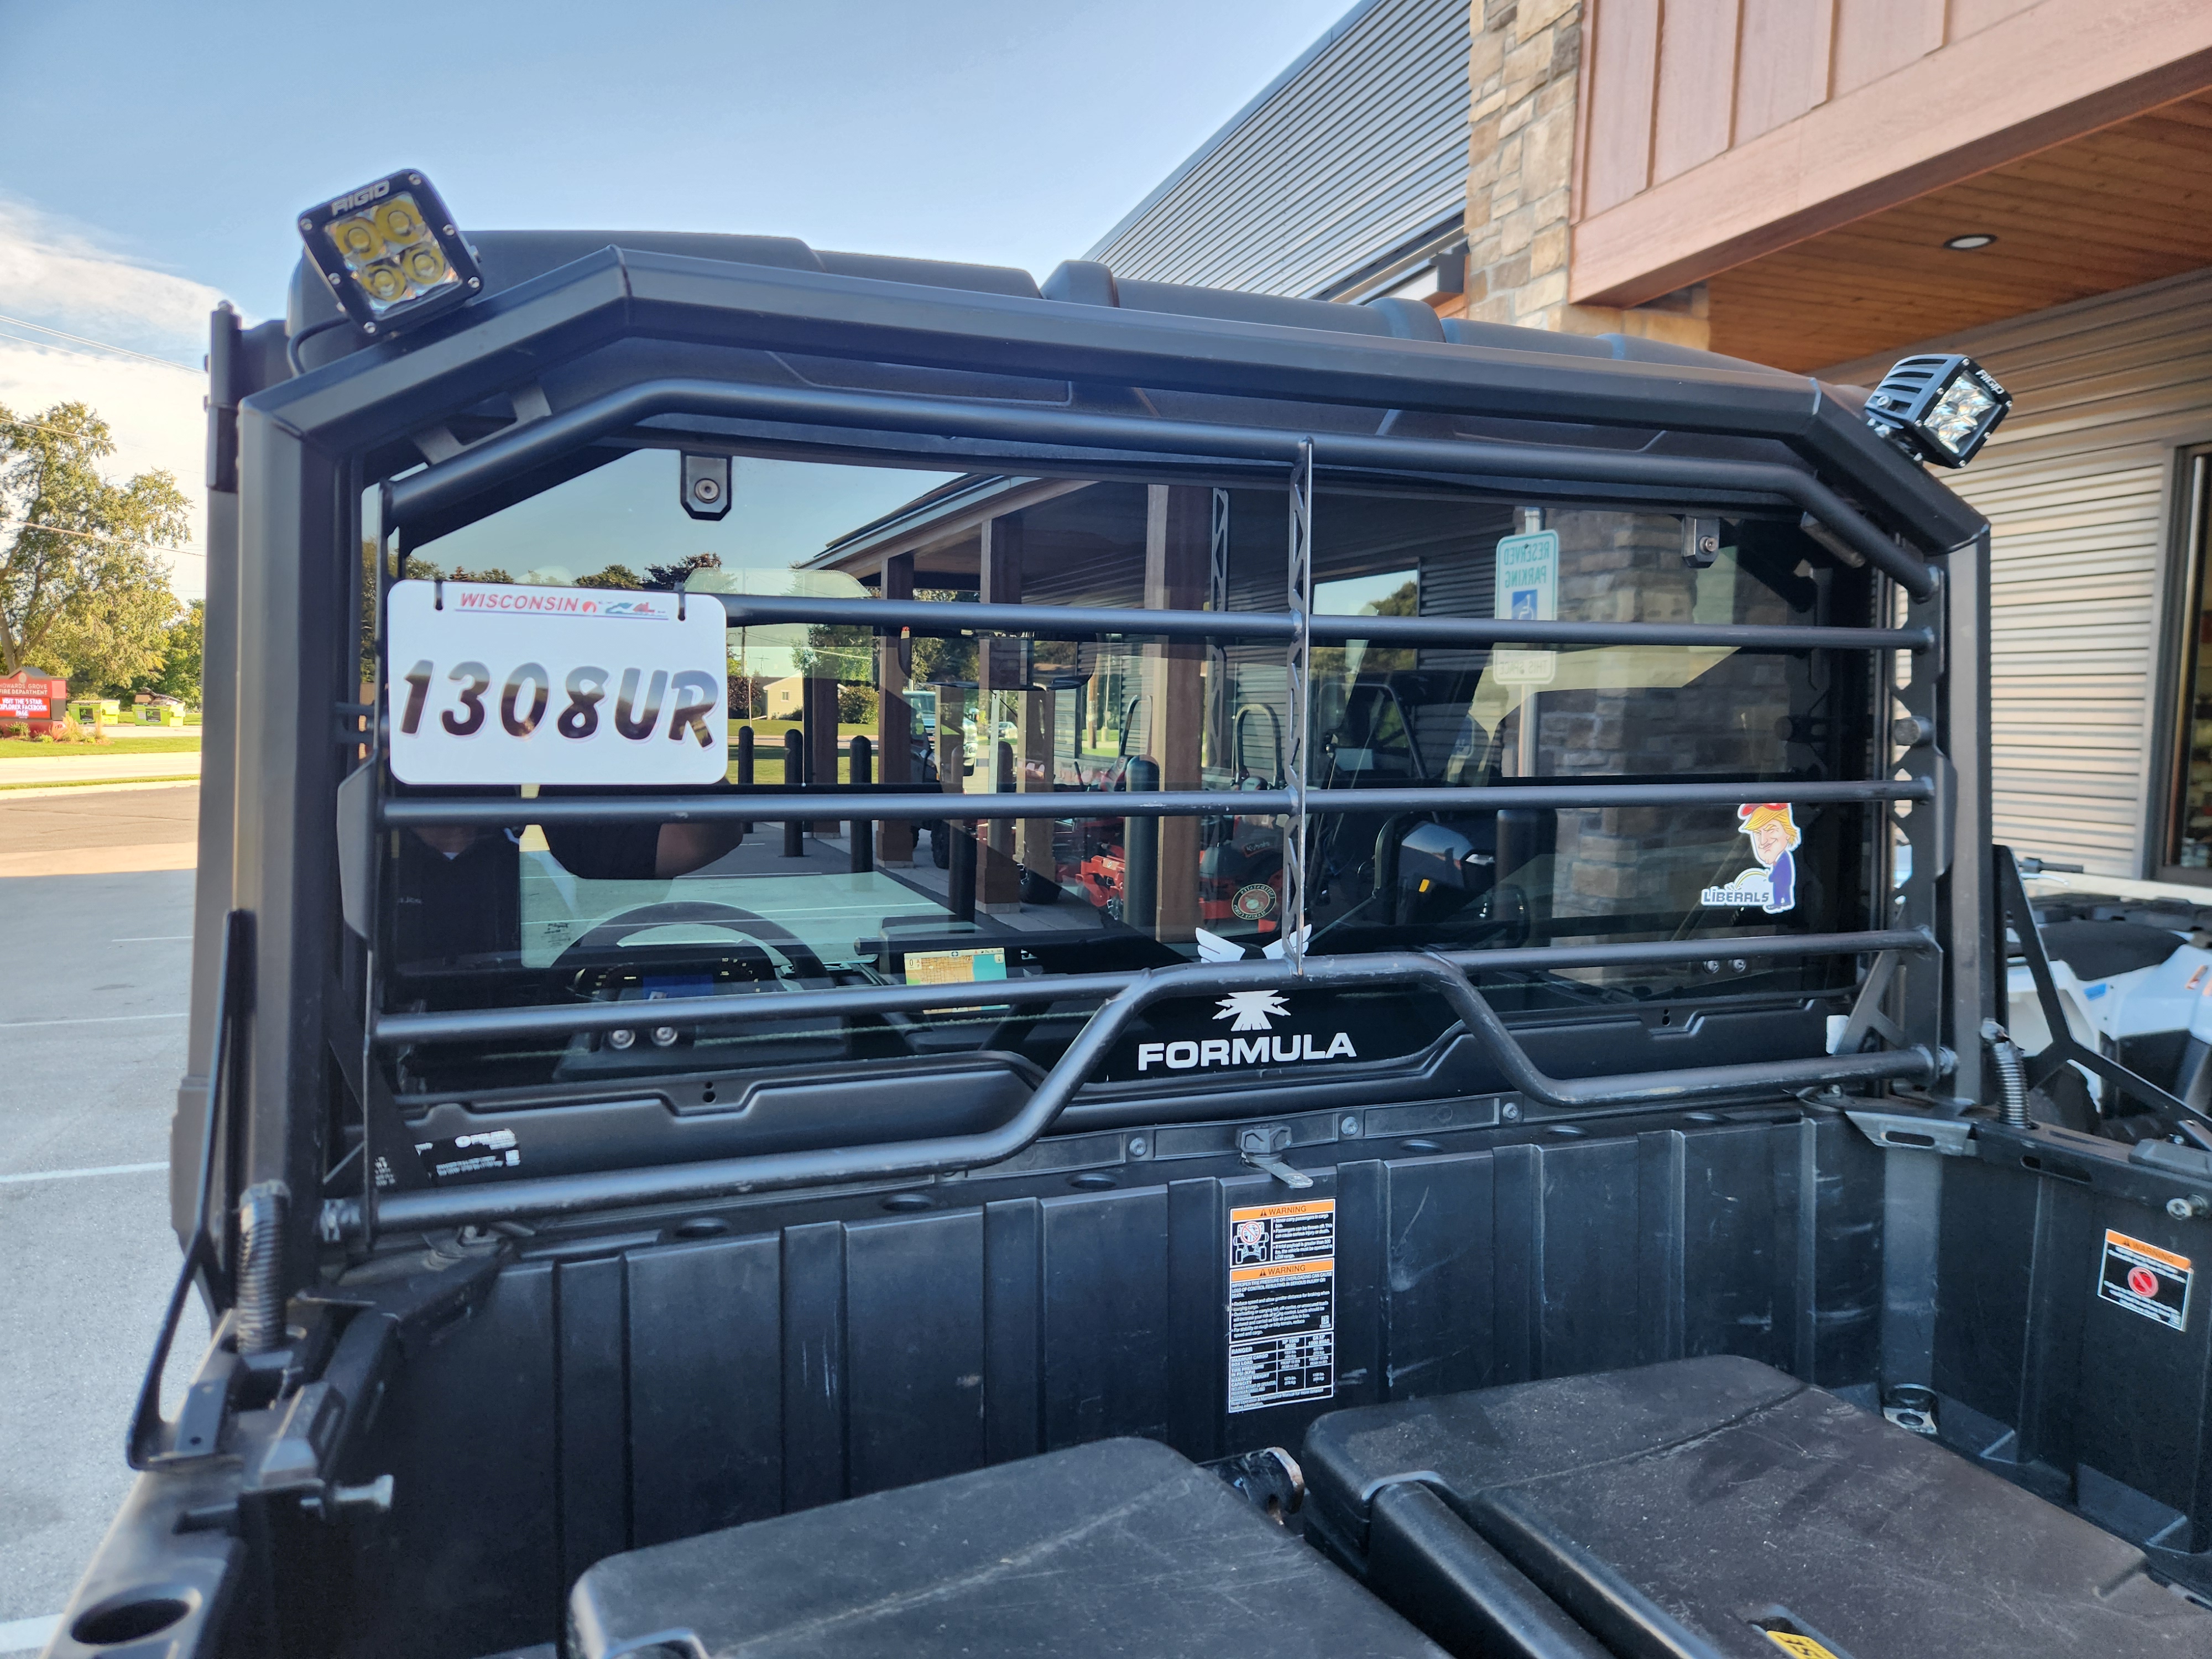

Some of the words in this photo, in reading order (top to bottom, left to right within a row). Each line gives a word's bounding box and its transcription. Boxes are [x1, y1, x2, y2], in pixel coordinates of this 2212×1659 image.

[332, 180, 389, 216] RIGID
[1975, 369, 2005, 395] RIGID
[459, 592, 578, 612] WISCONSIN
[399, 659, 719, 750] 1308UR
[1138, 1032, 1357, 1071] FORMULA
[1269, 1206, 1307, 1215] WARNING
[2133, 1243, 2174, 1263] WARNING
[1267, 1265, 1306, 1275] WARNING
[1231, 1346, 1253, 1354] RANGER
